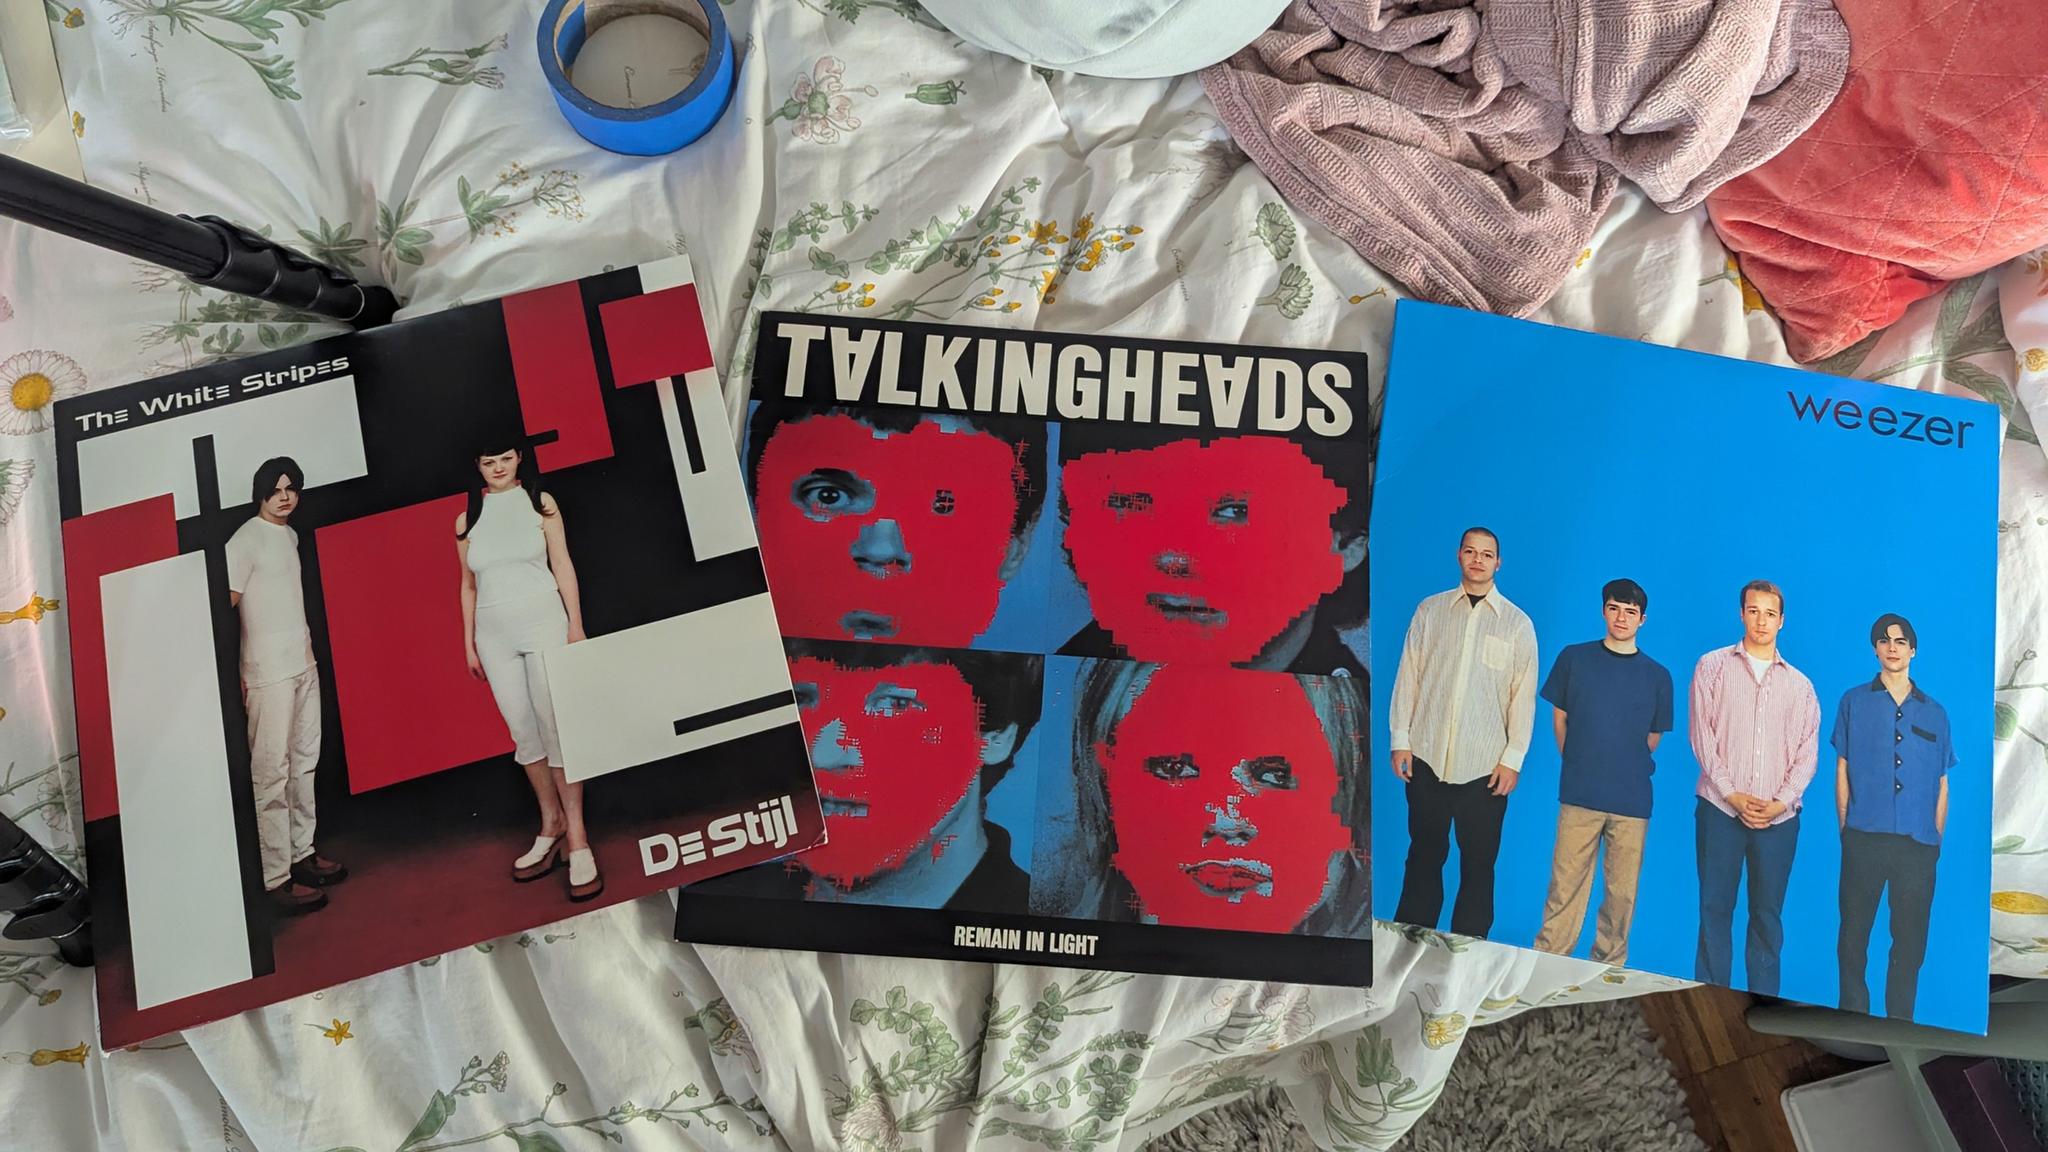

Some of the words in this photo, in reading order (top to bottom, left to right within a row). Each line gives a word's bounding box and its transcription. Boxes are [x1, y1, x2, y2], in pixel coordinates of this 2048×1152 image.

[75, 409, 129, 432] The
[139, 384, 230, 417] White
[241, 356, 350, 394] Stripes
[1786, 390, 1976, 449] weezer
[953, 925, 1021, 950] REMAIN
[1026, 930, 1044, 952] IN
[1049, 932, 1099, 956] LIGHT
